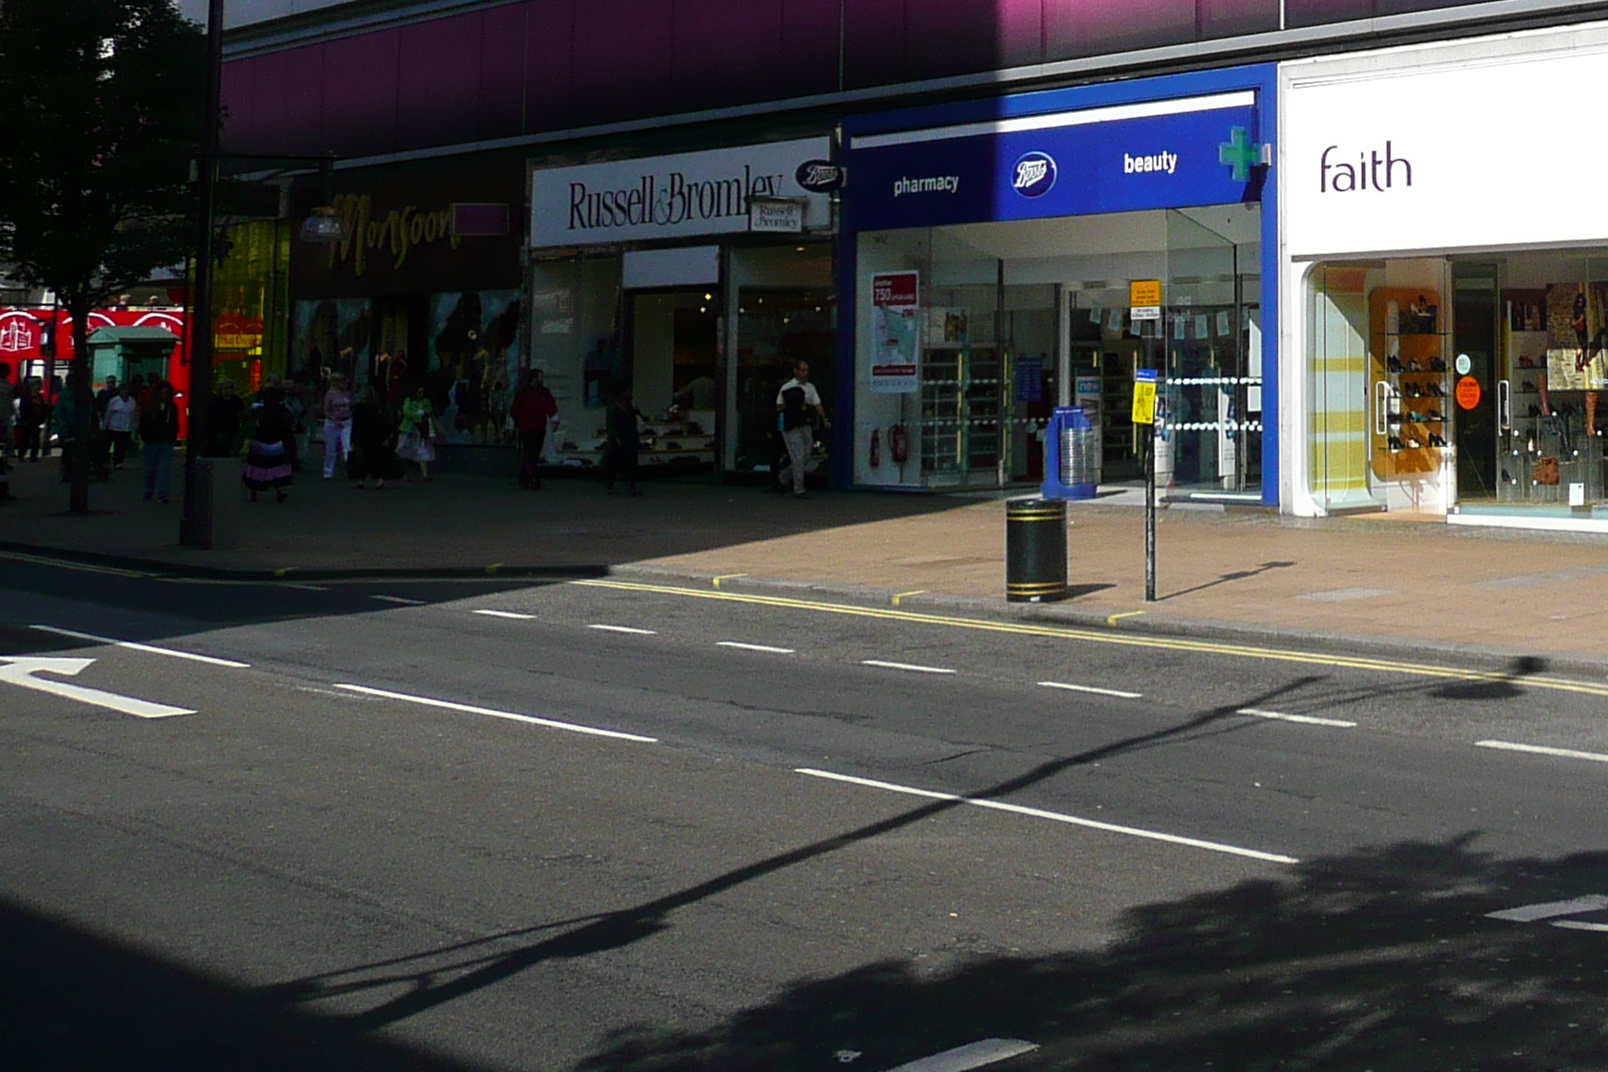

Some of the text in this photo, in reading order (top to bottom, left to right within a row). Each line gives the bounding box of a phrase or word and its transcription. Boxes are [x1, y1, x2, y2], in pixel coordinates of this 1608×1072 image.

[1124, 151, 1177, 174] beauty
[1321, 140, 1412, 193] faith
[802, 164, 840, 185] Boots
[1014, 160, 1048, 188] Boots
[894, 175, 959, 197] pharmacy
[875, 288, 891, 301] 750
